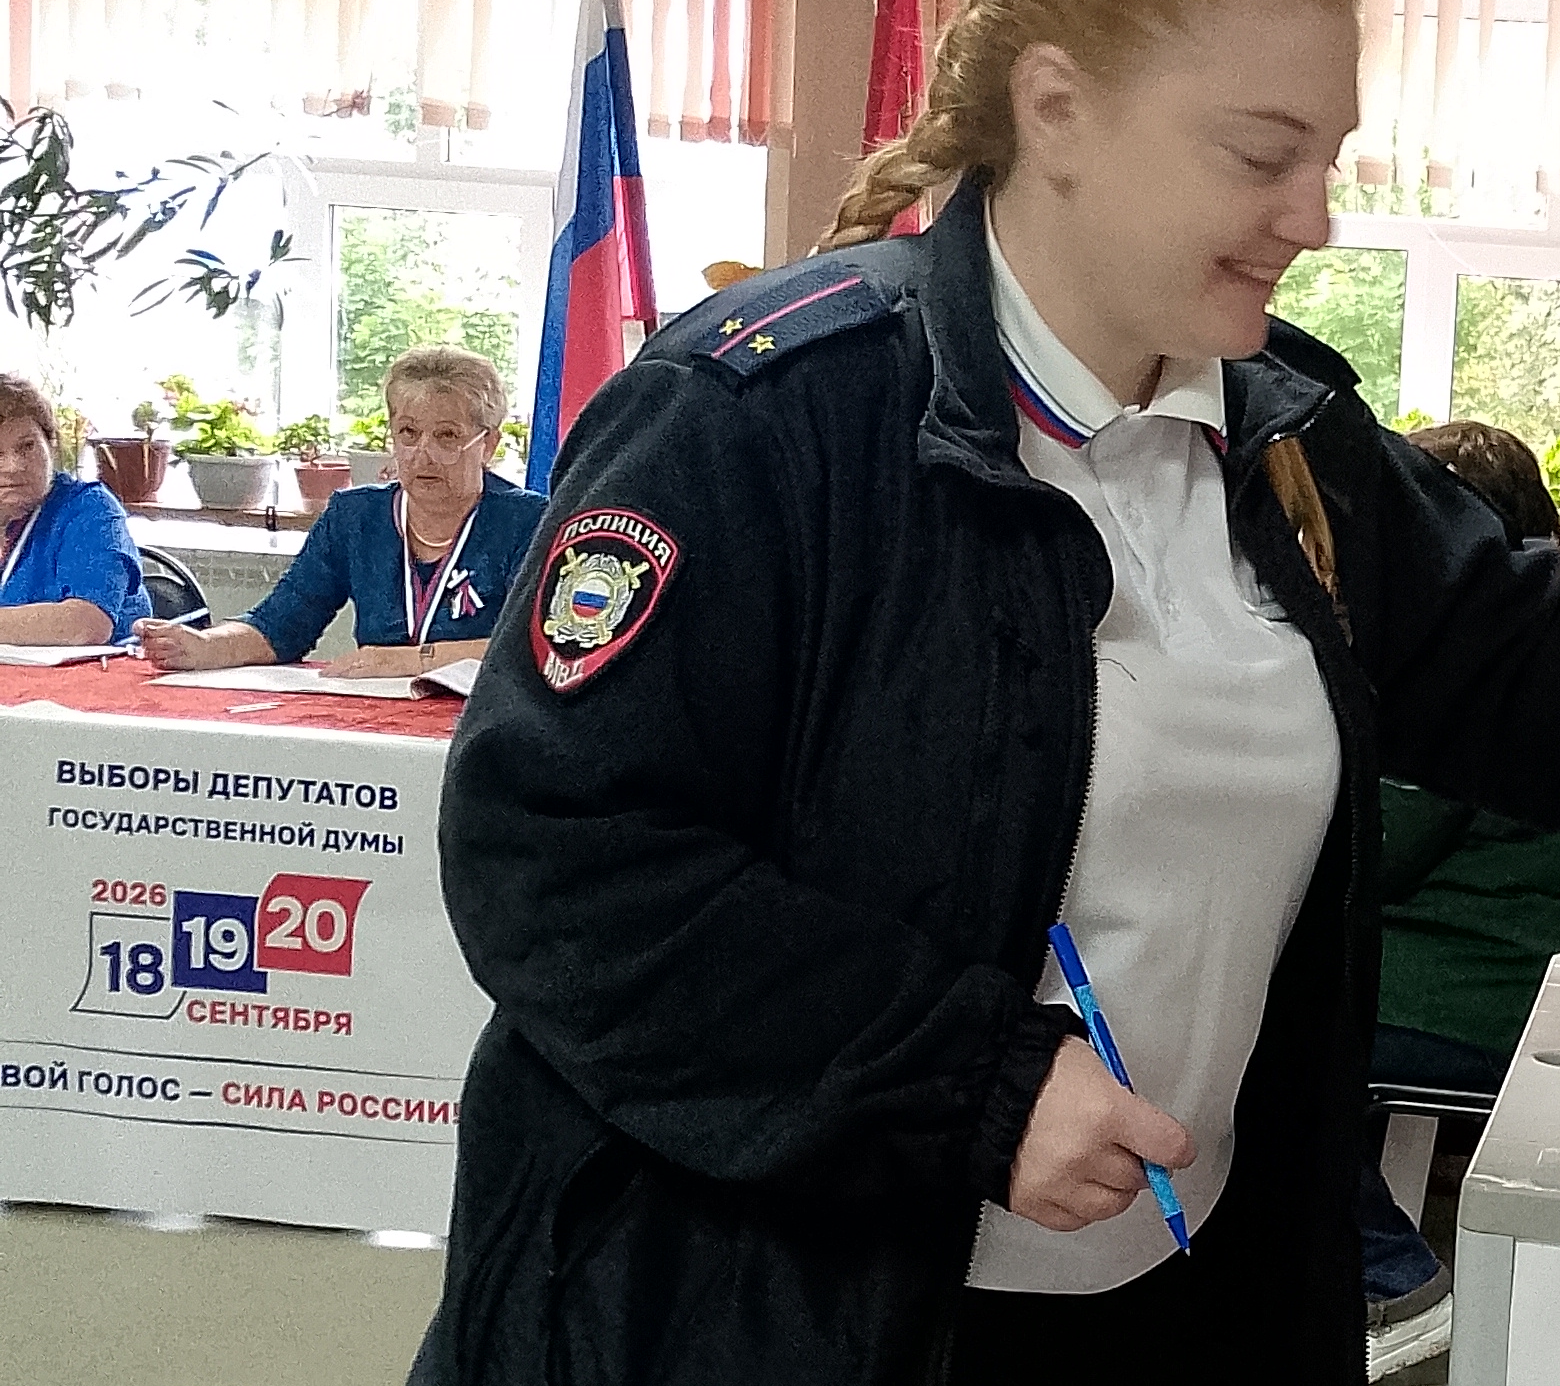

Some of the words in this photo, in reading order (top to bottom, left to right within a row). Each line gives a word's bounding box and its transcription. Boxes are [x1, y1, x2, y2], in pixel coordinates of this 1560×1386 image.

[561, 514, 672, 568] ПОЛИЦИЯ
[543, 650, 585, 688] МВД
[56, 759, 200, 795] ВЫБОРЫ
[207, 772, 398, 811] ДЕПУТАТОВ
[48, 806, 315, 847] ГОСУДАРСТВЕННОЙ
[321, 828, 404, 855] ДУМЫ
[91, 879, 168, 907] 2026
[100, 941, 165, 995] 18
[181, 916, 250, 971] 19
[264, 895, 348, 953] 20
[186, 999, 353, 1036] СЕНТЯБРЯ
[77, 1070, 181, 1101] ГОЛОС
[221, 1080, 308, 1112] СИЛА
